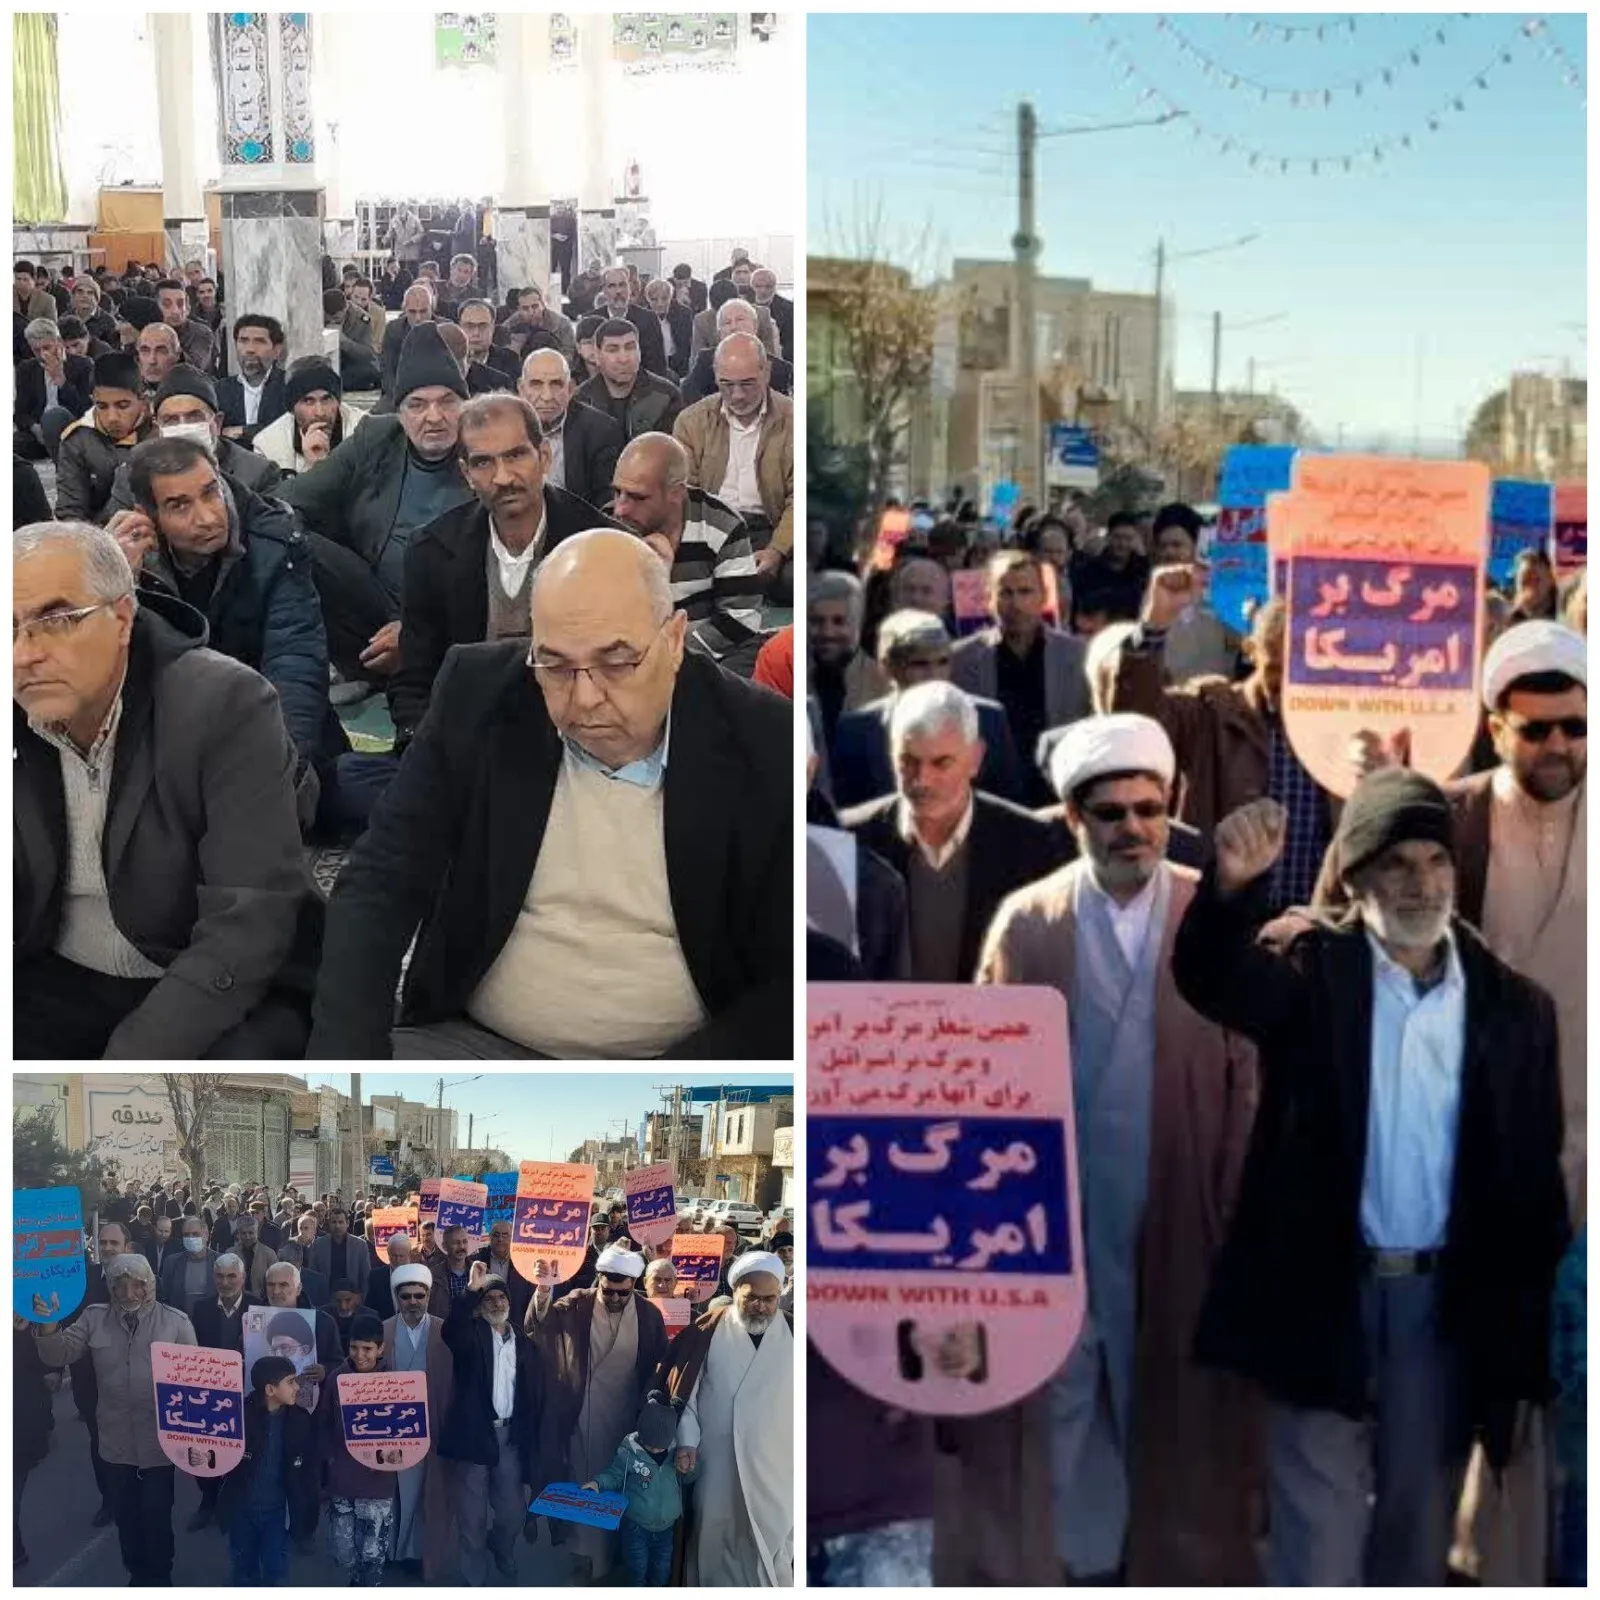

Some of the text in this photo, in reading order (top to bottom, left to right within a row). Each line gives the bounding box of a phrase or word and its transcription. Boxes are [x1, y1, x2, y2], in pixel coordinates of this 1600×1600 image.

[1309, 566, 1459, 621] مرگ بر
[1305, 627, 1461, 688] امریکا
[813, 1121, 1037, 1190] مرگ بر
[644, 1191, 669, 1203] مرگ
[522, 1203, 538, 1219] بر
[542, 1202, 581, 1222] مرگ
[631, 1202, 671, 1220] امریکا
[519, 1221, 581, 1245] امریکا
[812, 1198, 1047, 1268] امریکا
[899, 1285, 968, 1304] WITH
[165, 1390, 233, 1412] مرگ بر
[165, 1409, 236, 1435] امریکا
[353, 1404, 417, 1421] مرگ بر
[167, 1433, 194, 1443] DOWN
[196, 1436, 219, 1446] WITH
[351, 1421, 420, 1438] امریکا
